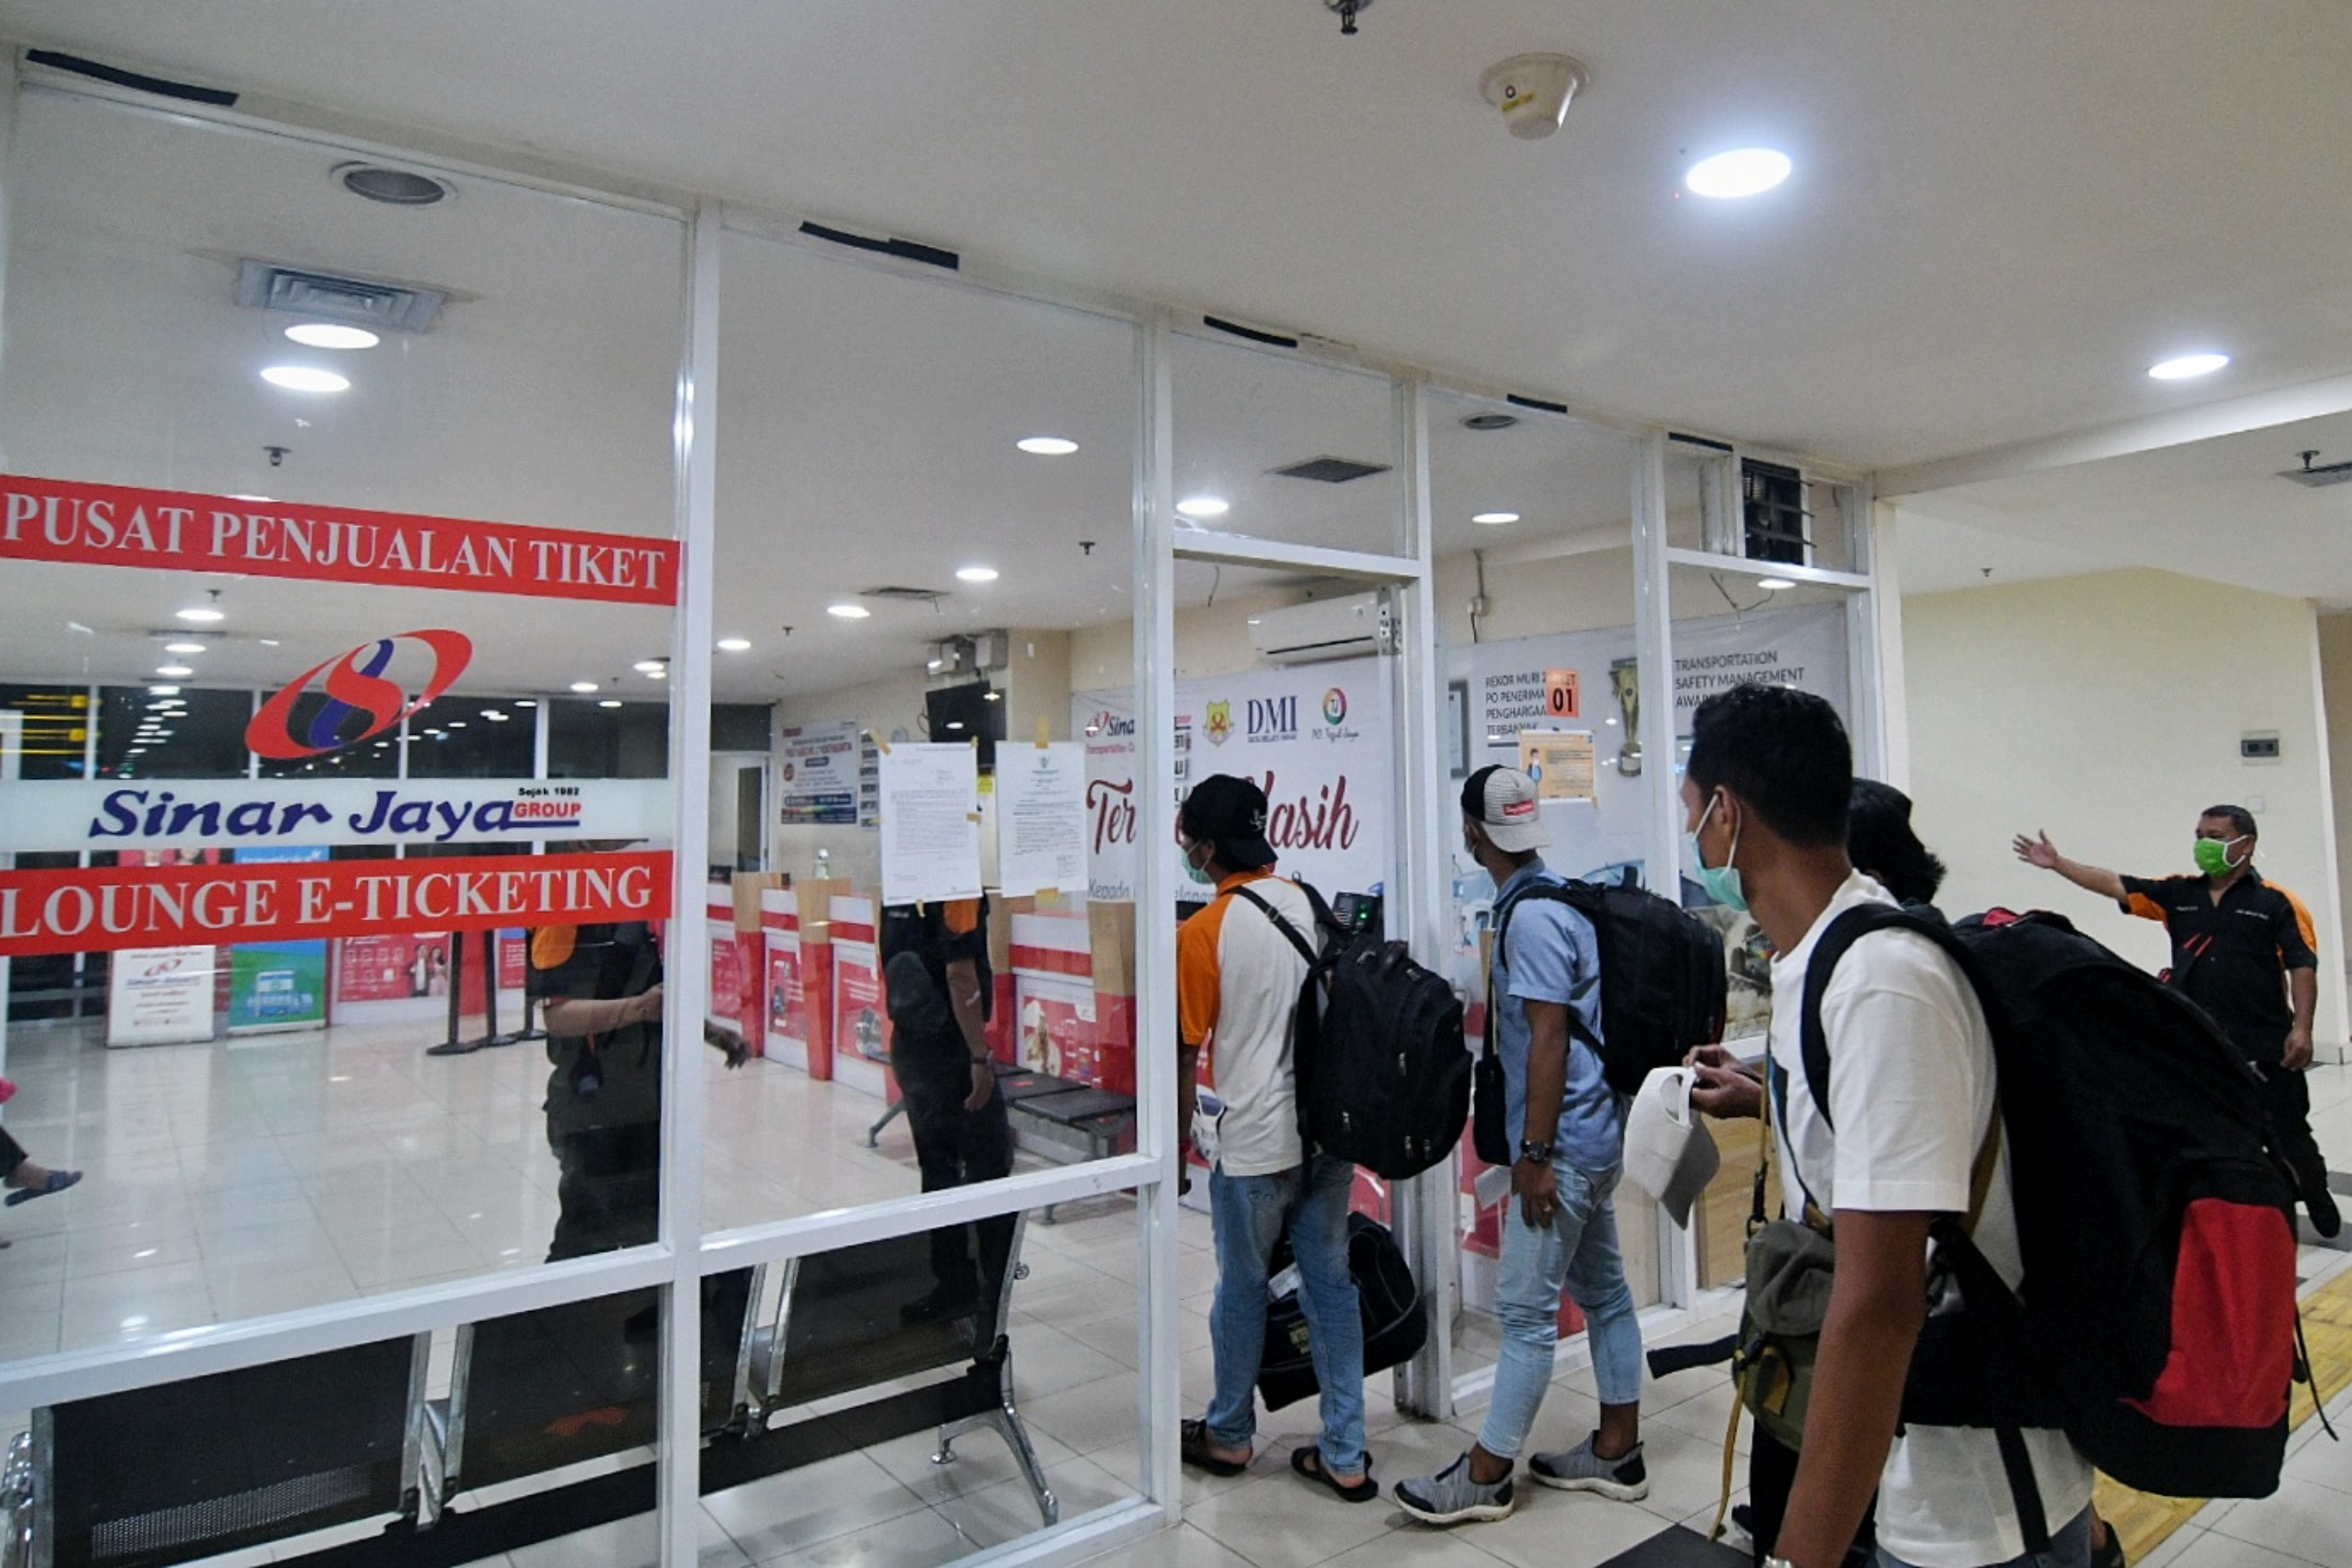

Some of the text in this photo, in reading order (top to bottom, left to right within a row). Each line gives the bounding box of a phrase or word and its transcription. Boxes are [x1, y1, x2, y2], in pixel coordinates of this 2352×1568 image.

[4, 492, 665, 589] PUSAT PENJUALAN TIKET
[1675, 651, 1778, 671] TRANSPORTATION
[1486, 675, 1515, 688] REKOR
[1517, 672, 1540, 684] MURI
[1675, 666, 1805, 690] SAFETY MANAGEMENT
[1486, 692, 1498, 703] PO
[1552, 688, 1573, 712] 01
[1675, 693, 1711, 708] AWAR
[1247, 696, 1298, 734] DMI
[1486, 705, 1546, 719] PENGHARGAA
[1107, 716, 1135, 736] Sina
[518, 787, 549, 798] Sejak
[89, 789, 582, 841] Sinar Jaya GROUP
[0, 866, 652, 938] LOUNGE E-TICKETING
